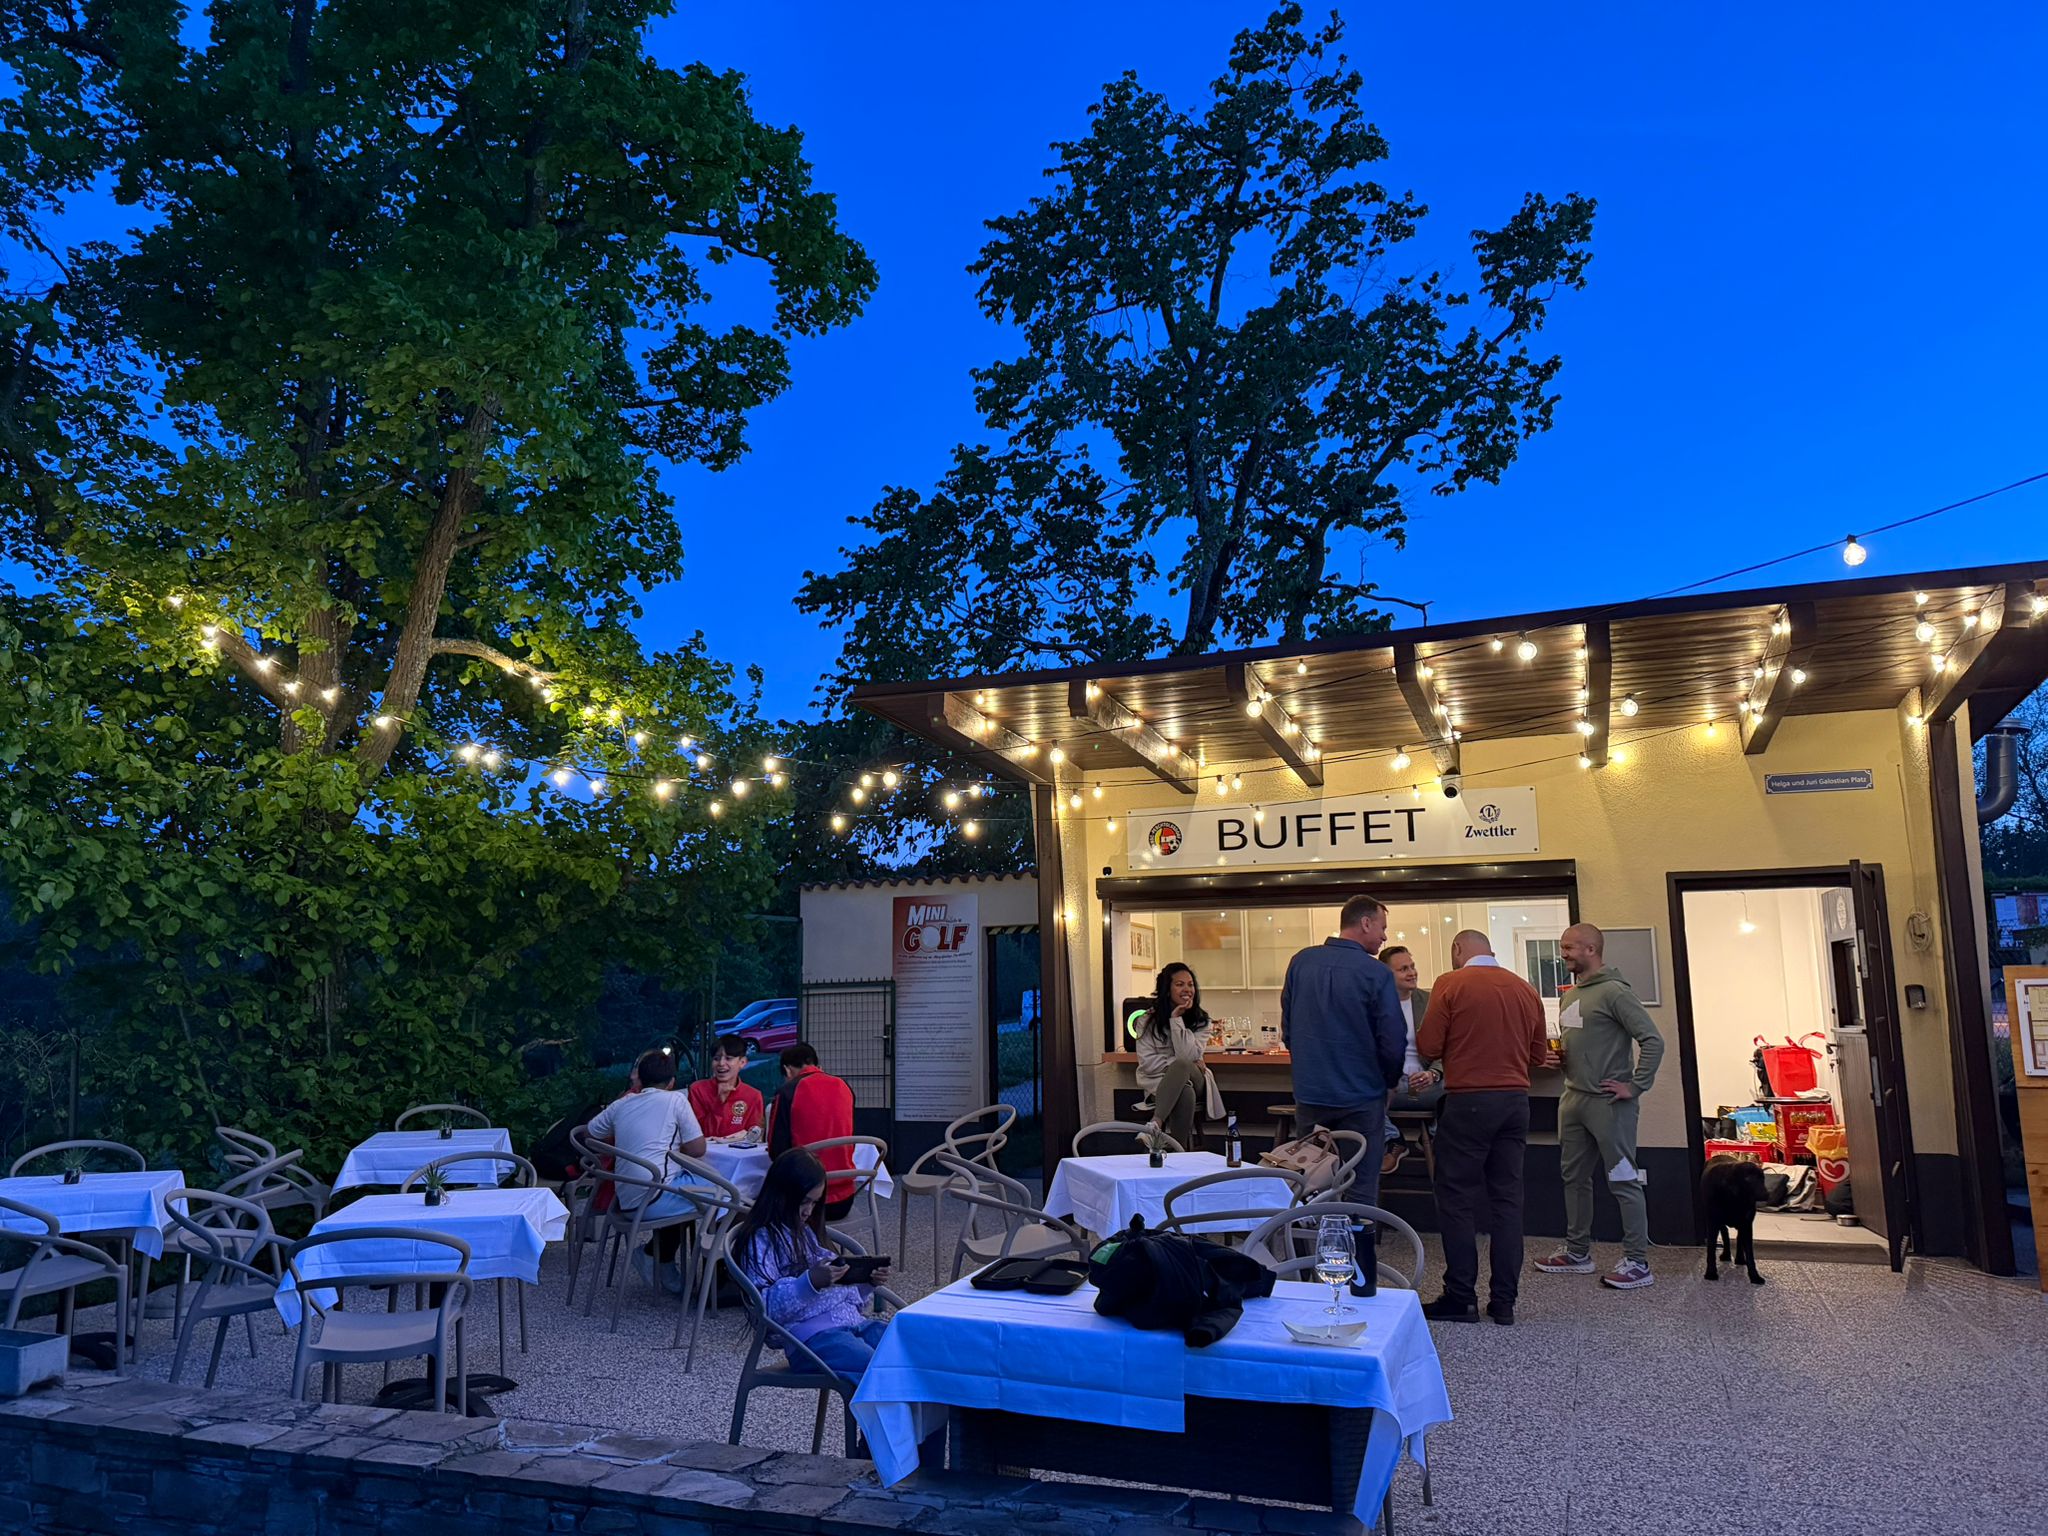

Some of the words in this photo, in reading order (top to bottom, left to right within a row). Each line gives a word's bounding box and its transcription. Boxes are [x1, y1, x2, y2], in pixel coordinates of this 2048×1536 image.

[1771, 780, 1790, 788] Helga
[1217, 808, 1426, 851] BUFFET
[1465, 824, 1517, 838] Zwettler
[903, 924, 969, 953] GOLF
